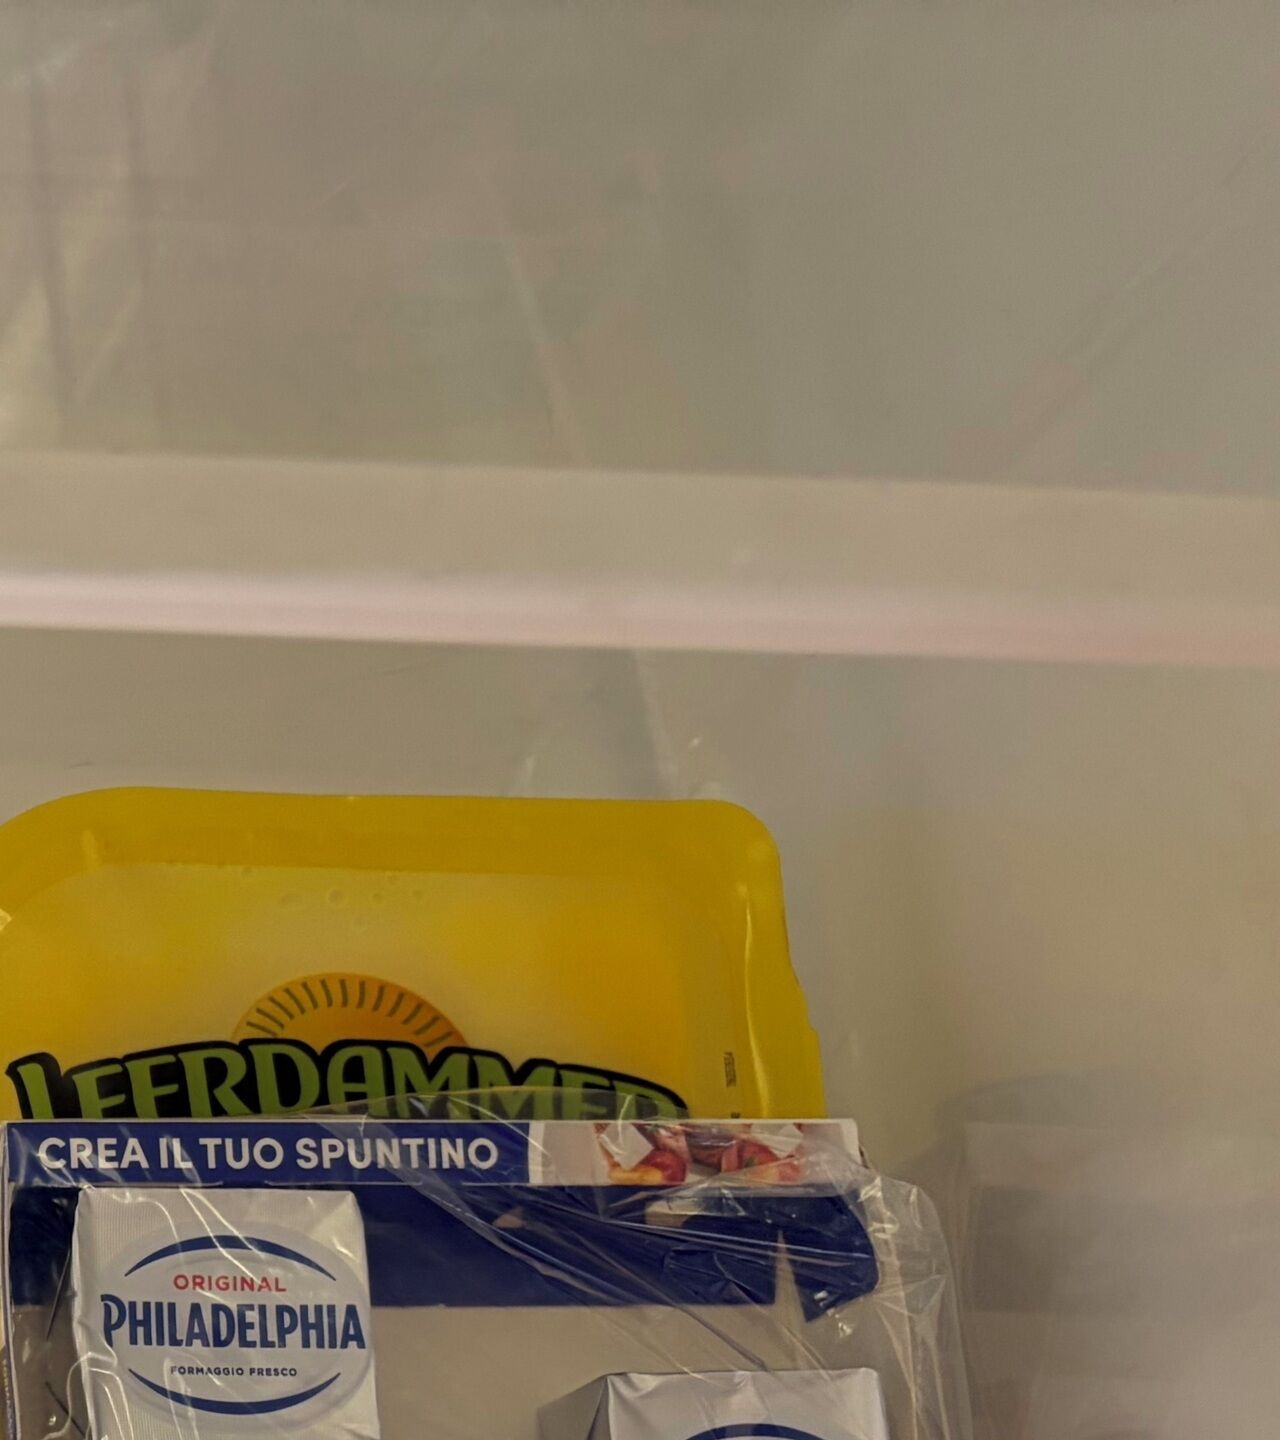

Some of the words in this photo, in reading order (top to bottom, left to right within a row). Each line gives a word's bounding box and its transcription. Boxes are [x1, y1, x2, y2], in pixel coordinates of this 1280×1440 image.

[37, 1136, 152, 1171] CREA
[157, 1136, 193, 1171] IL
[200, 1137, 286, 1172] TUO
[293, 1137, 499, 1173] SPUNTINO
[172, 1273, 288, 1293] ORIGINAL
[100, 1293, 367, 1350] PHILADELPHIA
[169, 1365, 245, 1378] FORMAGGIO
[248, 1366, 298, 1378] FRESCO
